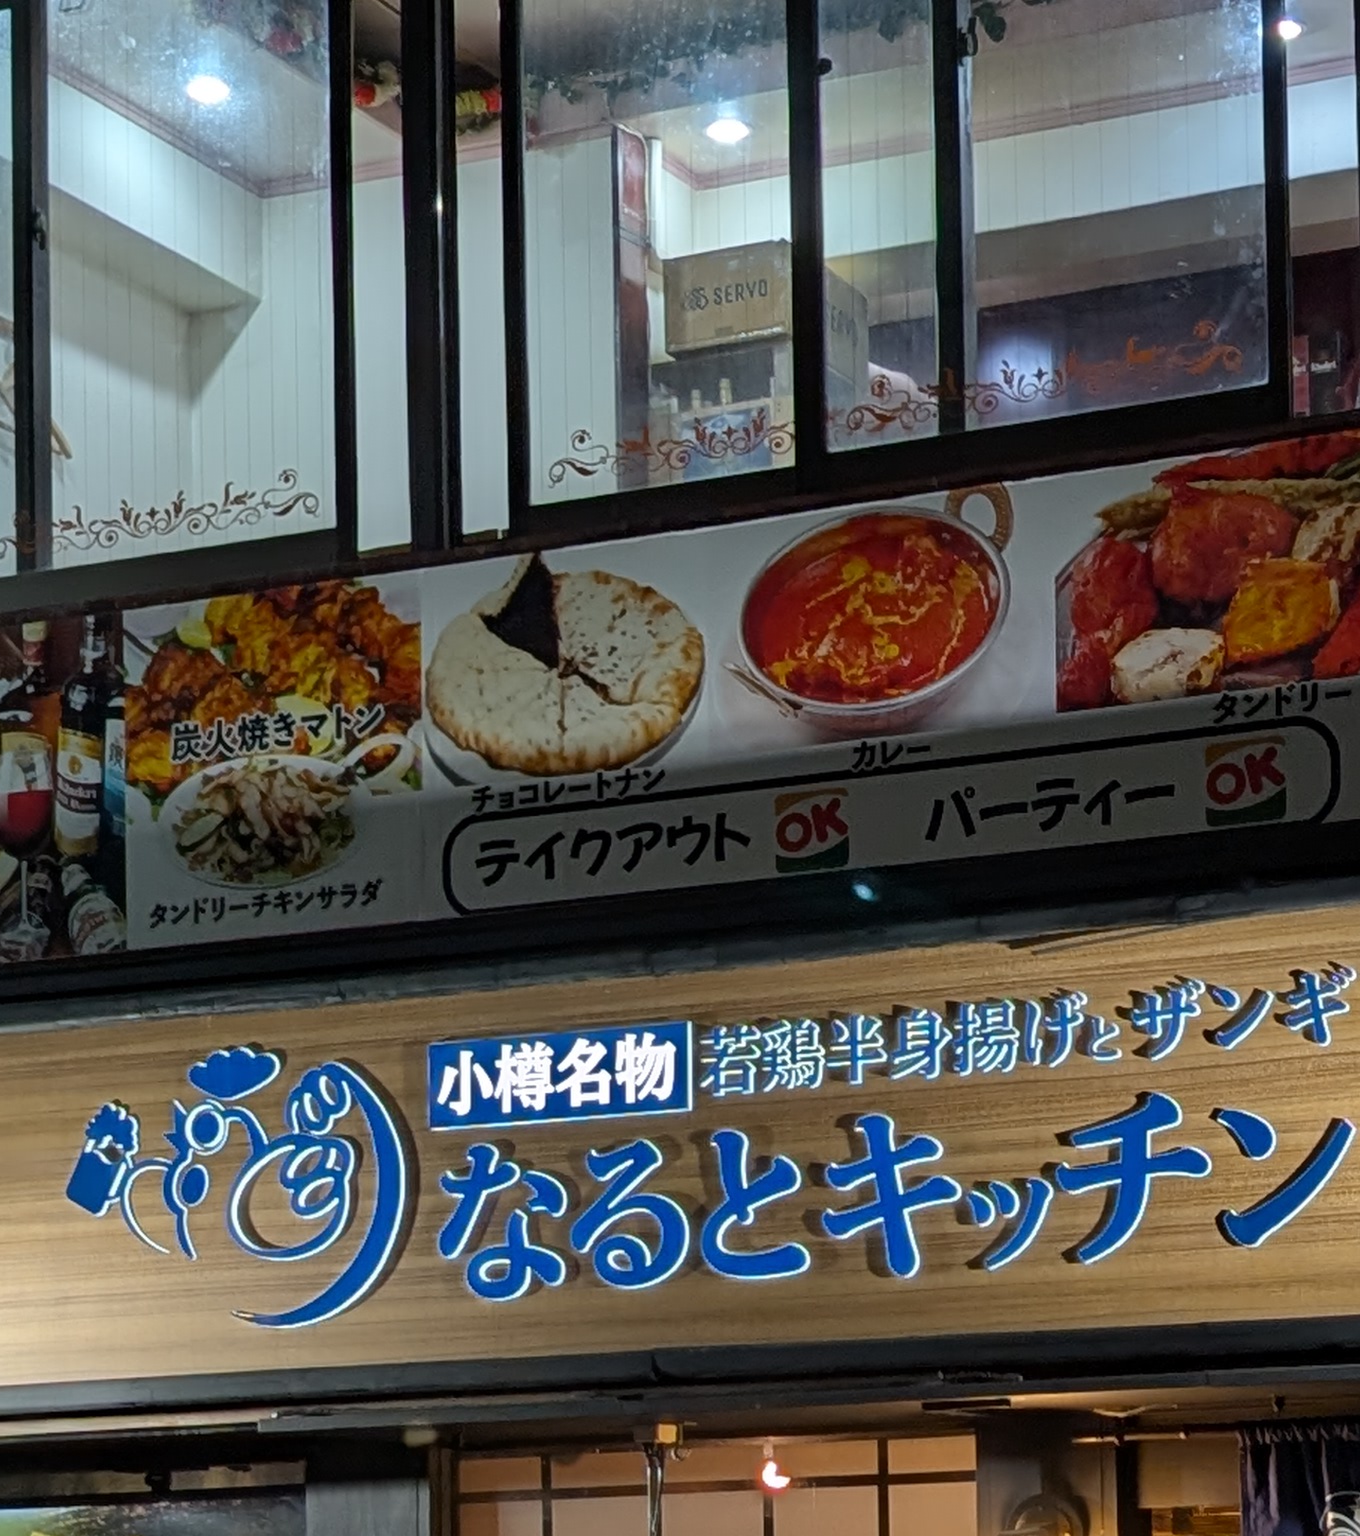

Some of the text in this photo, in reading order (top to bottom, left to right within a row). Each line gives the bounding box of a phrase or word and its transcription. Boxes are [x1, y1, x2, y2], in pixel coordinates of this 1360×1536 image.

[713, 278, 769, 305] SERVO
[1211, 682, 1352, 724] タンドリー
[170, 703, 386, 763] 炭火焼きマトン
[851, 740, 931, 771] カレー
[471, 769, 666, 814] チョコレートナン
[474, 745, 1287, 886] テイクアウト OK パーティー OK
[149, 879, 384, 929] タンドリーチキンサラダ
[437, 964, 1358, 1117] 小樽名物 若鶏半身揚げとザンギ
[439, 1090, 1357, 1301] なるとキッチン
